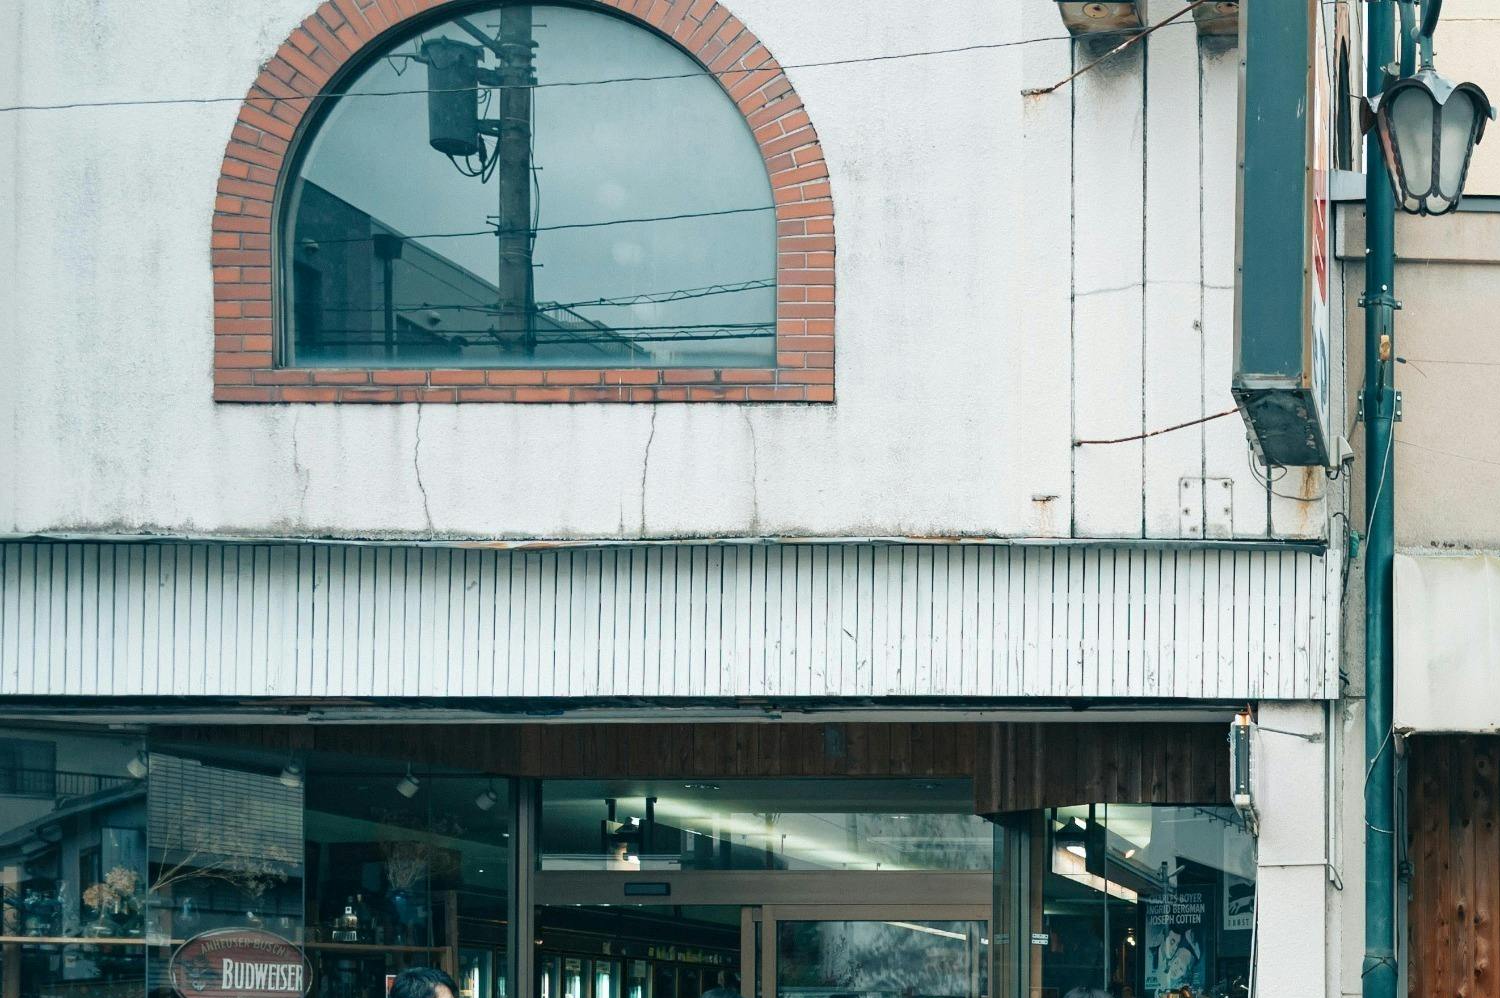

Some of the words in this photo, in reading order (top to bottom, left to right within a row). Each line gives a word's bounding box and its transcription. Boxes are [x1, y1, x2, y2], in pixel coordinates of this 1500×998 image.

[1179, 892, 1203, 903] BOYER
[1147, 904, 1171, 915] INGRID
[1173, 903, 1206, 914] BERGMAN
[1150, 914, 1175, 926] JOSEPH
[1175, 913, 1201, 925] COTTEN
[221, 957, 303, 992] BUDWEISER
